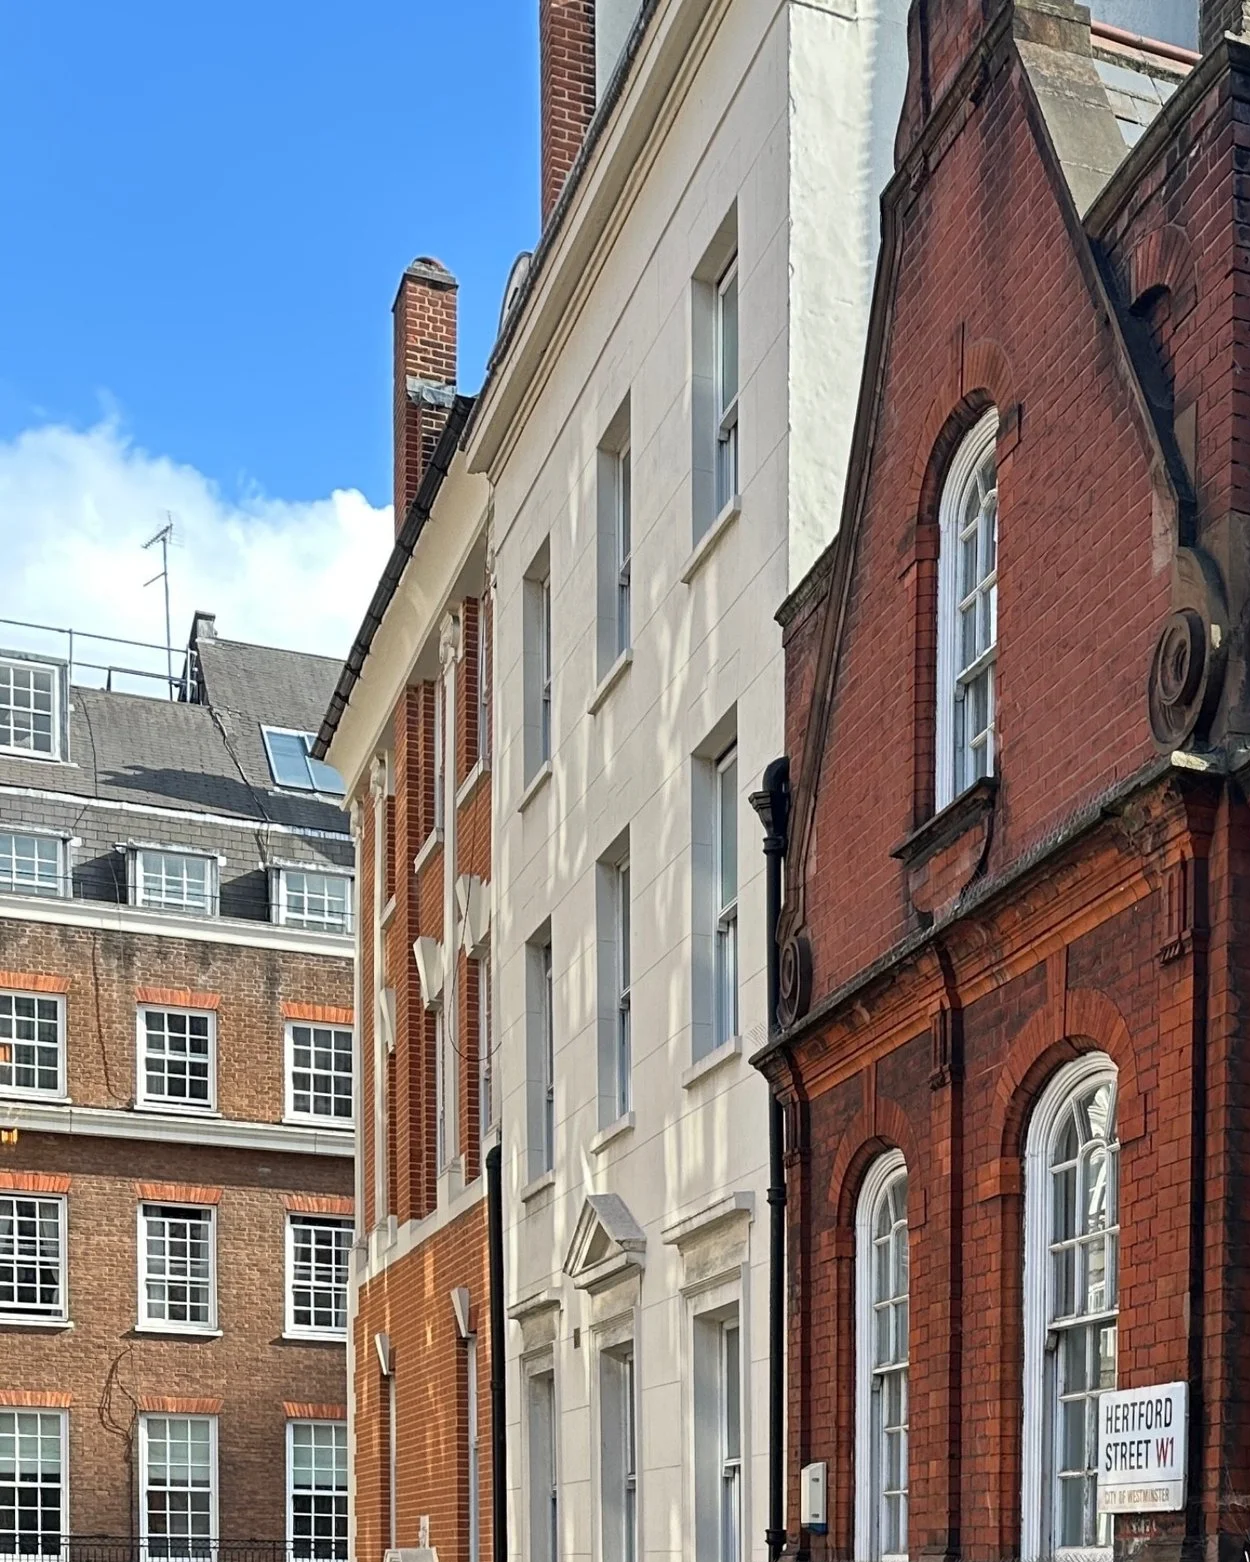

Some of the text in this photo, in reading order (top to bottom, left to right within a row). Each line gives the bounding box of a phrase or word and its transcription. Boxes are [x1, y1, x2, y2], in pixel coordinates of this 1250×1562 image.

[1106, 1398, 1172, 1434] HERTFORD
[1105, 1437, 1174, 1472] STREET W1
[1104, 1488, 1170, 1505] CITY OF WESTMINSTER
